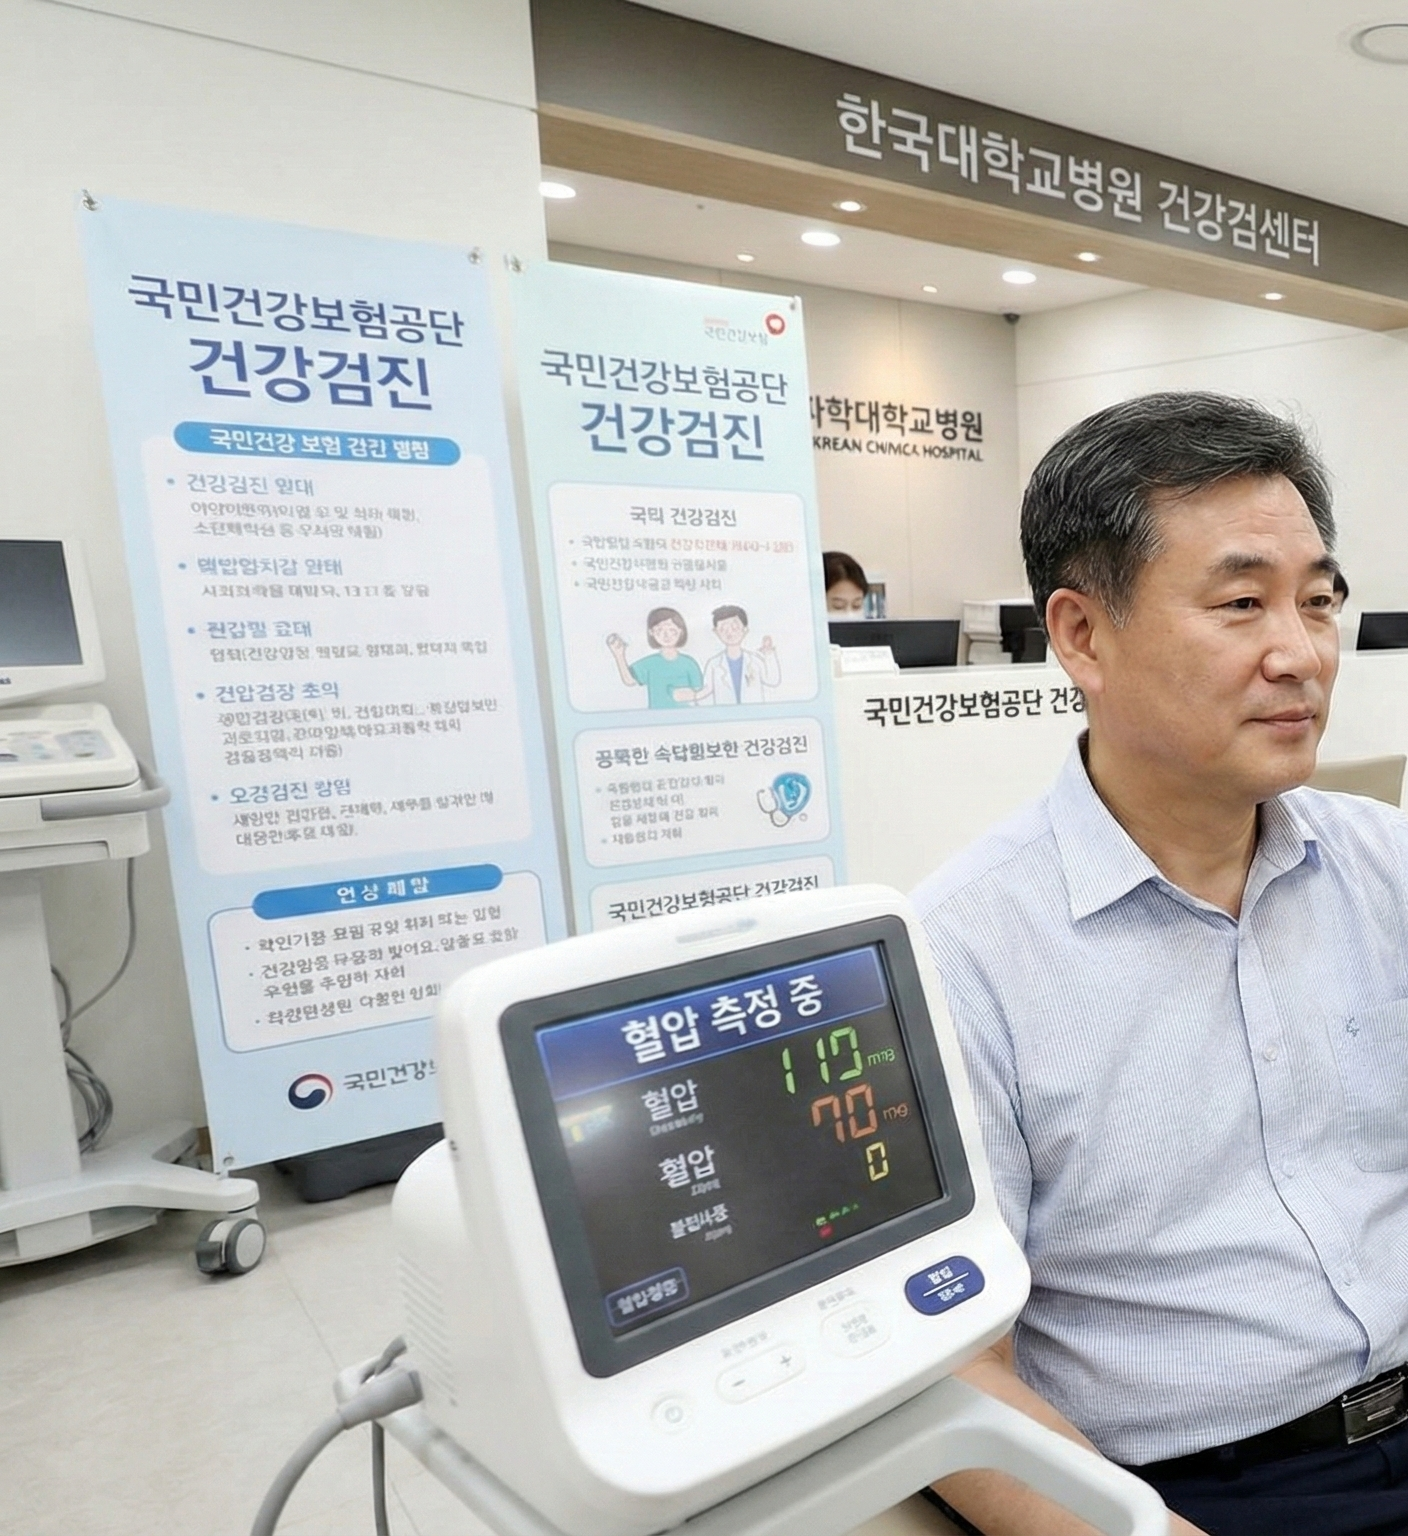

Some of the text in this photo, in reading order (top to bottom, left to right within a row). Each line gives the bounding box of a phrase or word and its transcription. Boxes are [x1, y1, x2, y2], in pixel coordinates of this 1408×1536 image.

[836, 93, 1321, 267] 한국대학교병원 건강검센터
[127, 273, 465, 348] 국민건강보험공단
[188, 337, 433, 411] 건강검진
[541, 349, 788, 406] 국민건강보험공단
[209, 428, 296, 454] 국민건강
[581, 402, 765, 461] 건강검진
[923, 445, 984, 462] HOSPITAL
[671, 507, 738, 528] 건강검진
[864, 689, 1043, 727] 국민건강보험공단
[621, 974, 824, 1065] 혈압 측정 중
[641, 1079, 699, 1122] 혈압
[811, 1083, 878, 1143] 70
